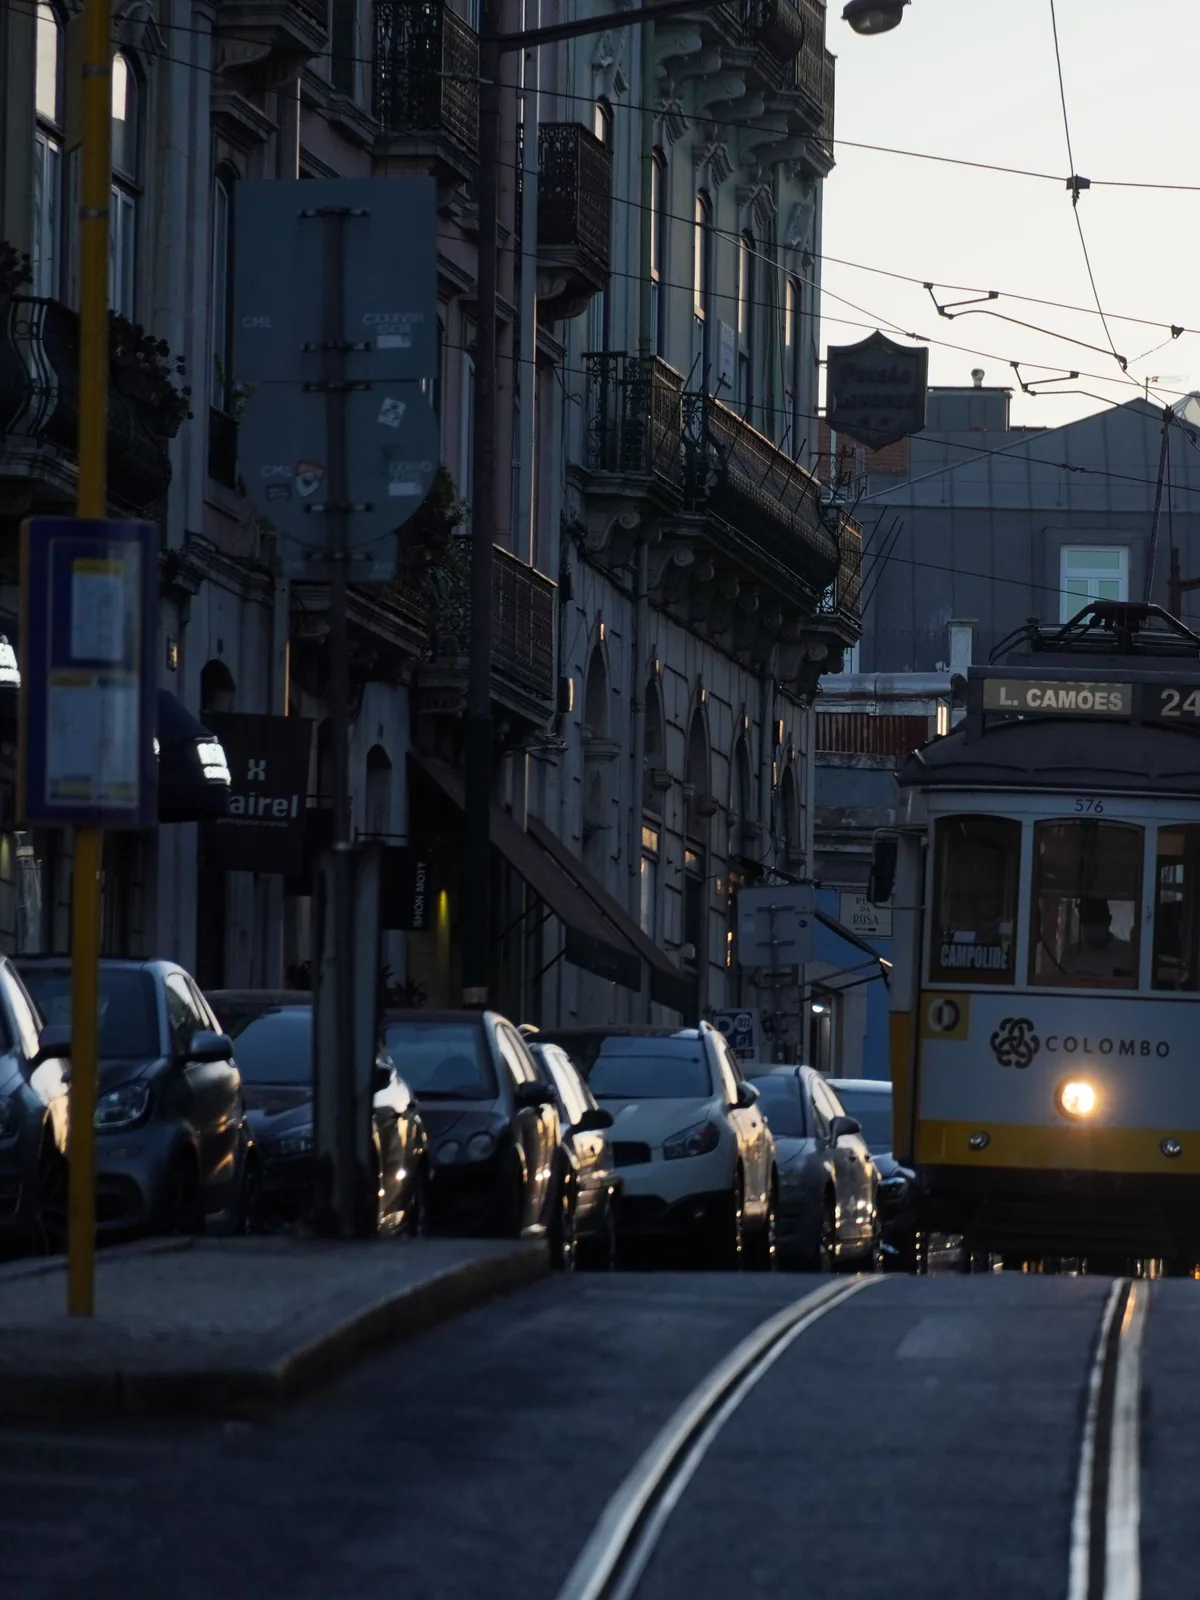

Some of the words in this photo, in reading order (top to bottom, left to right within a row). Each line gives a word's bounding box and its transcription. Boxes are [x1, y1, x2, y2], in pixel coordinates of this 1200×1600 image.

[999, 687, 1018, 706] L.
[1074, 798, 1104, 814] 576
[853, 913, 880, 925] ROSA
[940, 944, 1009, 970] CAMPOLIDE
[1045, 1035, 1171, 1058] COLOMBO
